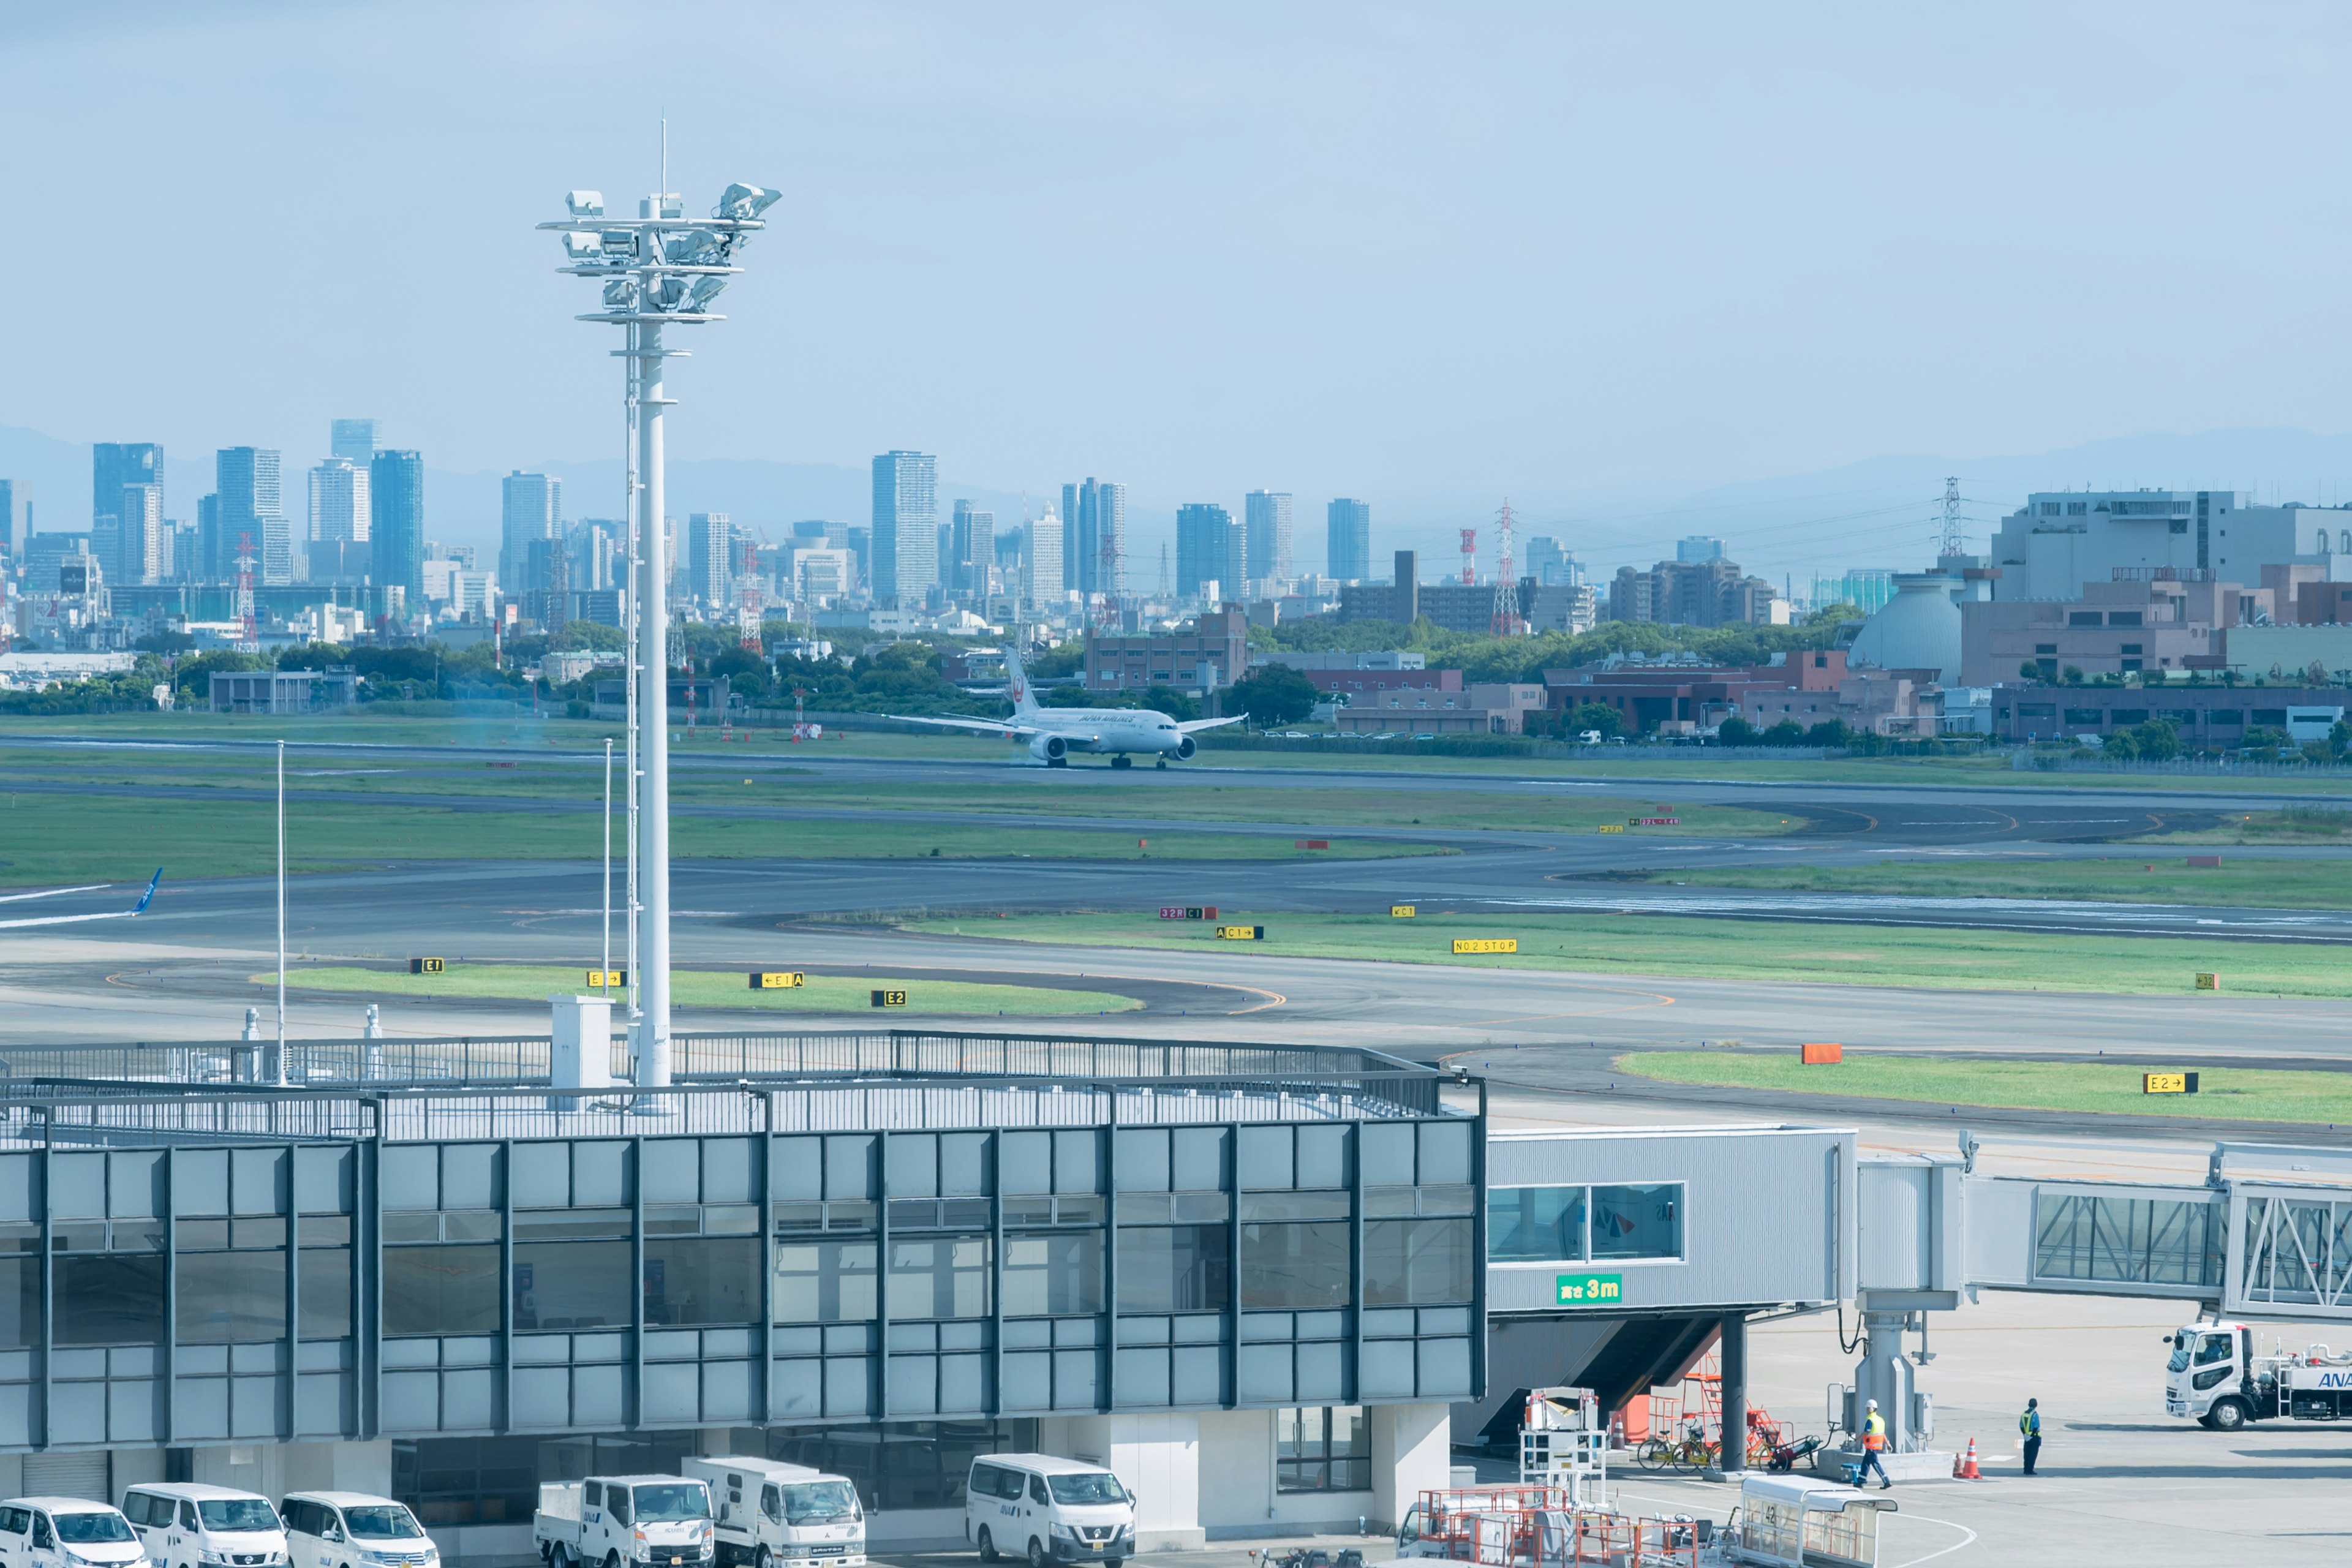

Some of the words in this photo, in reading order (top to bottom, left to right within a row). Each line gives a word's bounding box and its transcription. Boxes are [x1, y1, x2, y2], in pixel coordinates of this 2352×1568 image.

[1162, 909, 1183, 918] 32R
[1217, 928, 1224, 938] A
[1485, 941, 1514, 950] STOP
[426, 960, 440, 970] E1
[775, 976, 788, 985] E1
[794, 975, 802, 985] A
[2204, 977, 2212, 986] 32
[888, 992, 903, 1003] E2
[2152, 1077, 2168, 1088] E2
[1561, 1286, 1583, 1299] 高さ
[1587, 1279, 1618, 1298] 3m
[2318, 1373, 2352, 1387] ANA
[1000, 1504, 1012, 1516] ANA
[1766, 1506, 1774, 1524] 42
[584, 1511, 595, 1523] ANA
